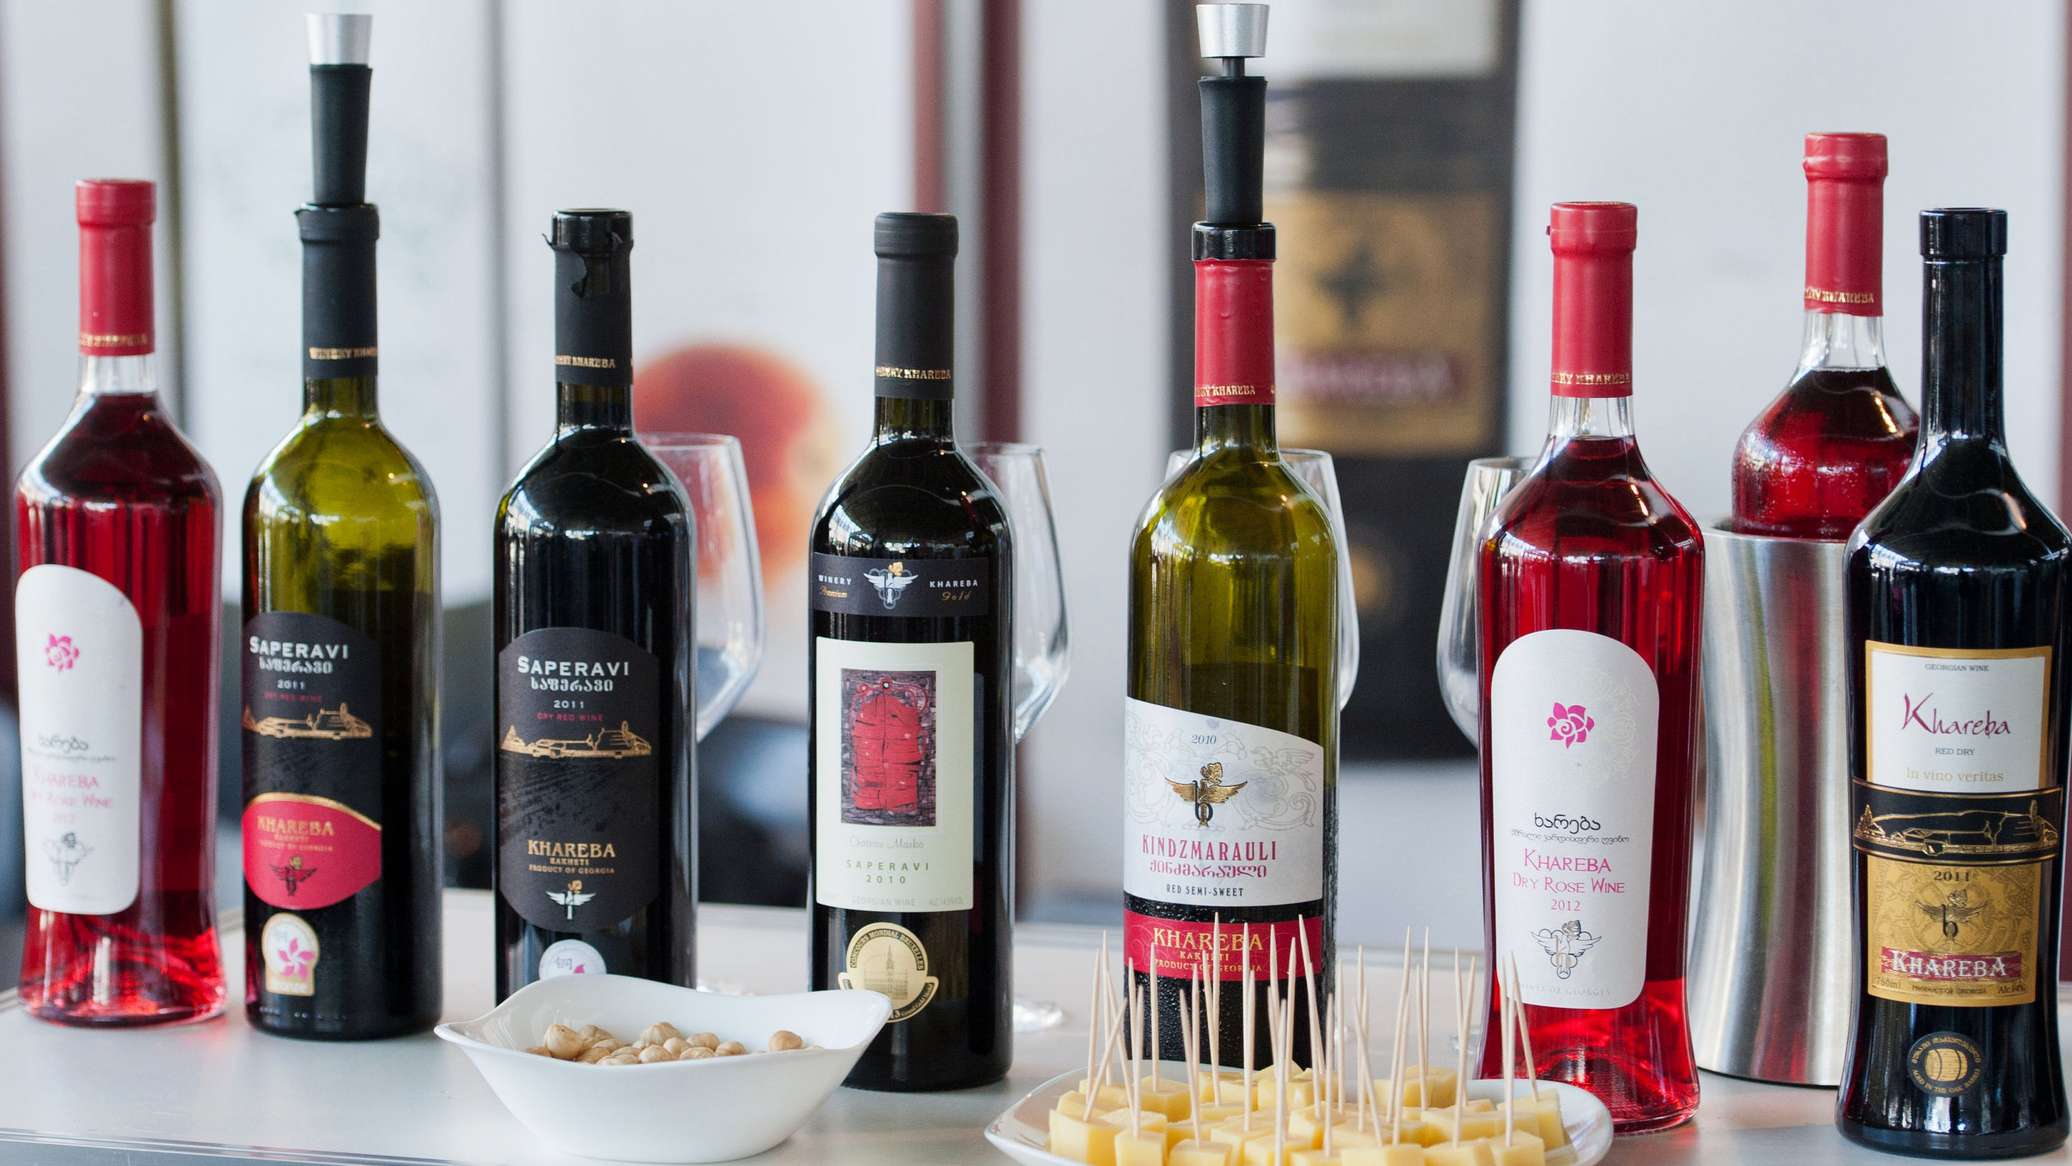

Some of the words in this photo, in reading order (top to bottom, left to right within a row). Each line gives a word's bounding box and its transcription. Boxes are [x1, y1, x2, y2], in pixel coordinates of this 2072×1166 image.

[929, 580, 978, 589] KHAREBA
[942, 591, 972, 601] Gold
[249, 635, 349, 659] SAPERAVI
[517, 655, 630, 677] SAPERAVI
[1969, 664, 1990, 672] WINE
[277, 679, 306, 690] 2011
[553, 700, 585, 709] 2011
[556, 713, 576, 721] RED
[578, 713, 605, 722] WINE
[1902, 692, 2011, 738] Khareba
[1191, 734, 1217, 745] 2010
[1935, 746, 1954, 755] RED
[1956, 747, 1976, 756] DRY
[1923, 769, 1953, 782] vino
[1957, 770, 2005, 783] veritas
[257, 816, 335, 837] KHAREBA
[527, 839, 616, 858] KHAREBA
[1142, 834, 1277, 861] KINDZMARAULI
[846, 859, 929, 872] SAPERAVI
[1524, 848, 1612, 874] KHAREBA
[528, 864, 563, 874] PRODUCT
[564, 867, 576, 875] OF
[578, 867, 616, 875] GEORGIA
[866, 874, 906, 884] 2010
[1513, 872, 1538, 890] DRY
[1545, 876, 1585, 894] ROSE
[1591, 877, 1625, 894] WINE
[1934, 871, 1970, 882] 2011
[1166, 884, 1182, 895] RED
[1185, 885, 1245, 897] SEMI-SWEET
[1551, 898, 1581, 912] 2012
[1153, 927, 1264, 951] KHAREBA
[1890, 950, 2008, 978] KHAREBA
